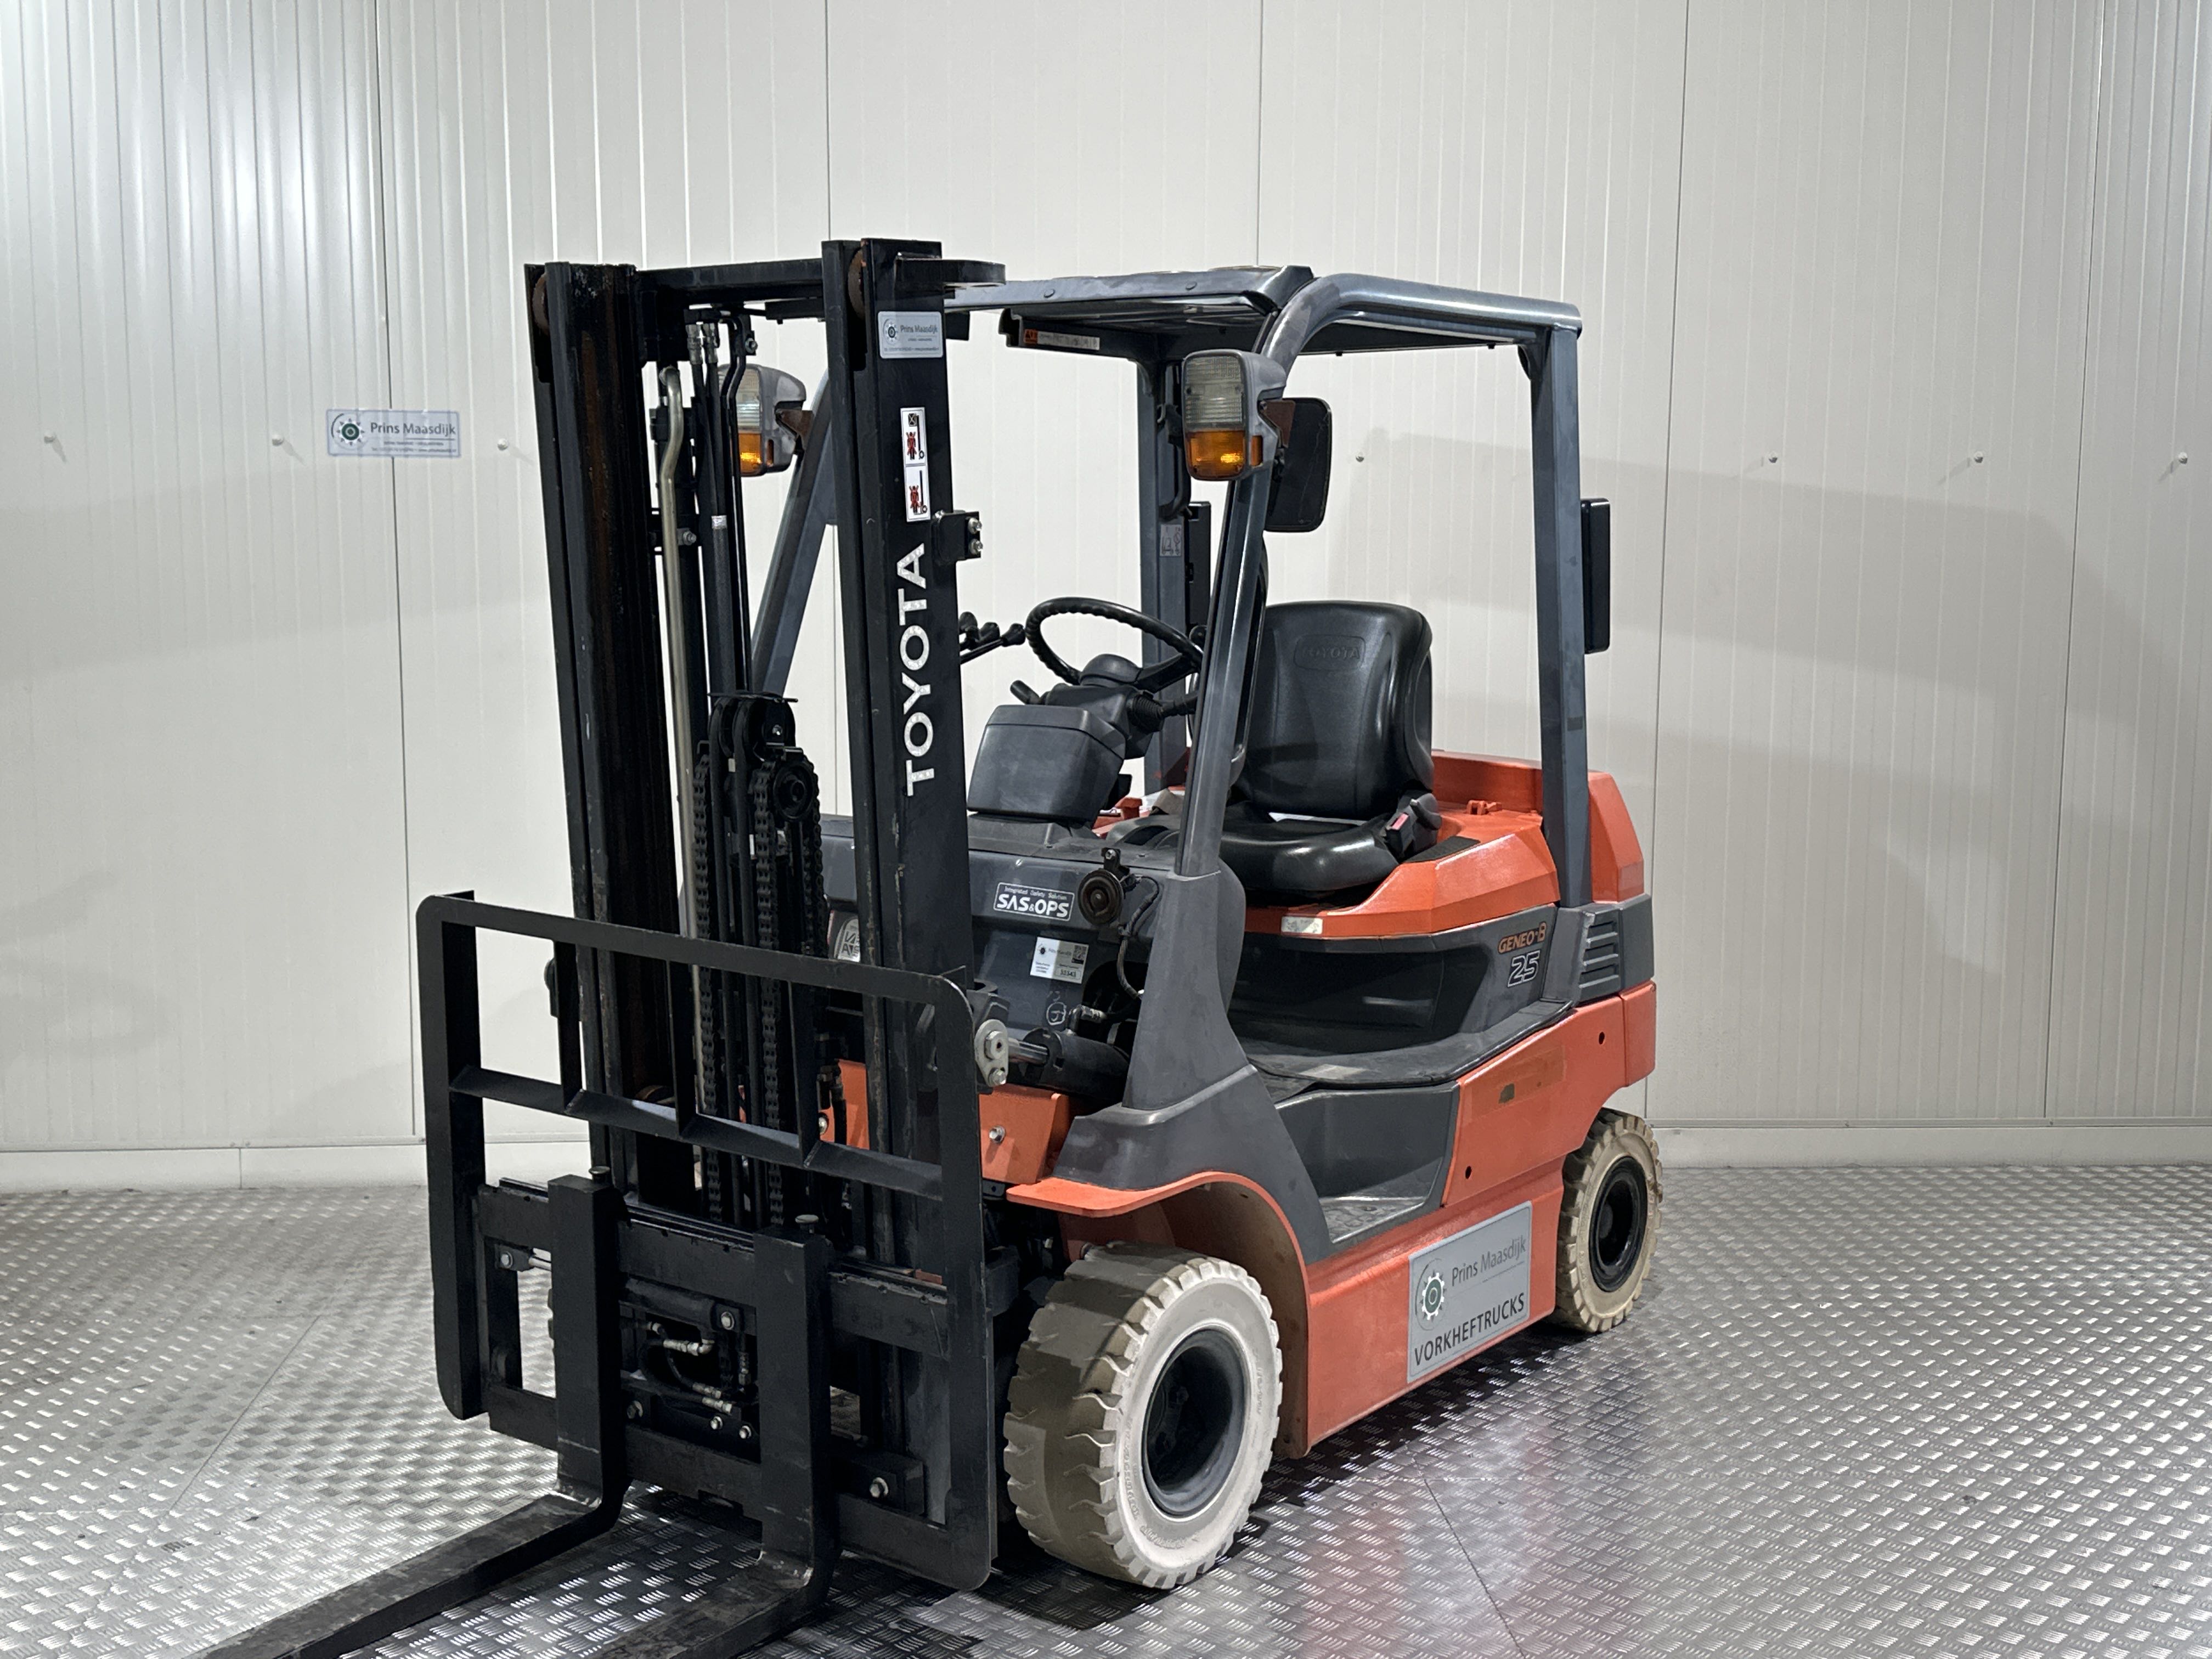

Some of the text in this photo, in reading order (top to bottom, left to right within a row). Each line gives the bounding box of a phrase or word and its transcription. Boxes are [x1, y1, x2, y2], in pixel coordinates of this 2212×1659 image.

[370, 422, 456, 437] Prins Maasdijk
[896, 542, 935, 797] TOYOTA
[1004, 885, 1029, 895] Integrated
[1030, 890, 1046, 898] Safety
[1507, 950, 1541, 988] 25
[1452, 1234, 1527, 1287] Prins Maasdijk
[1414, 1293, 1525, 1366] VORKHEFTRUCKS
